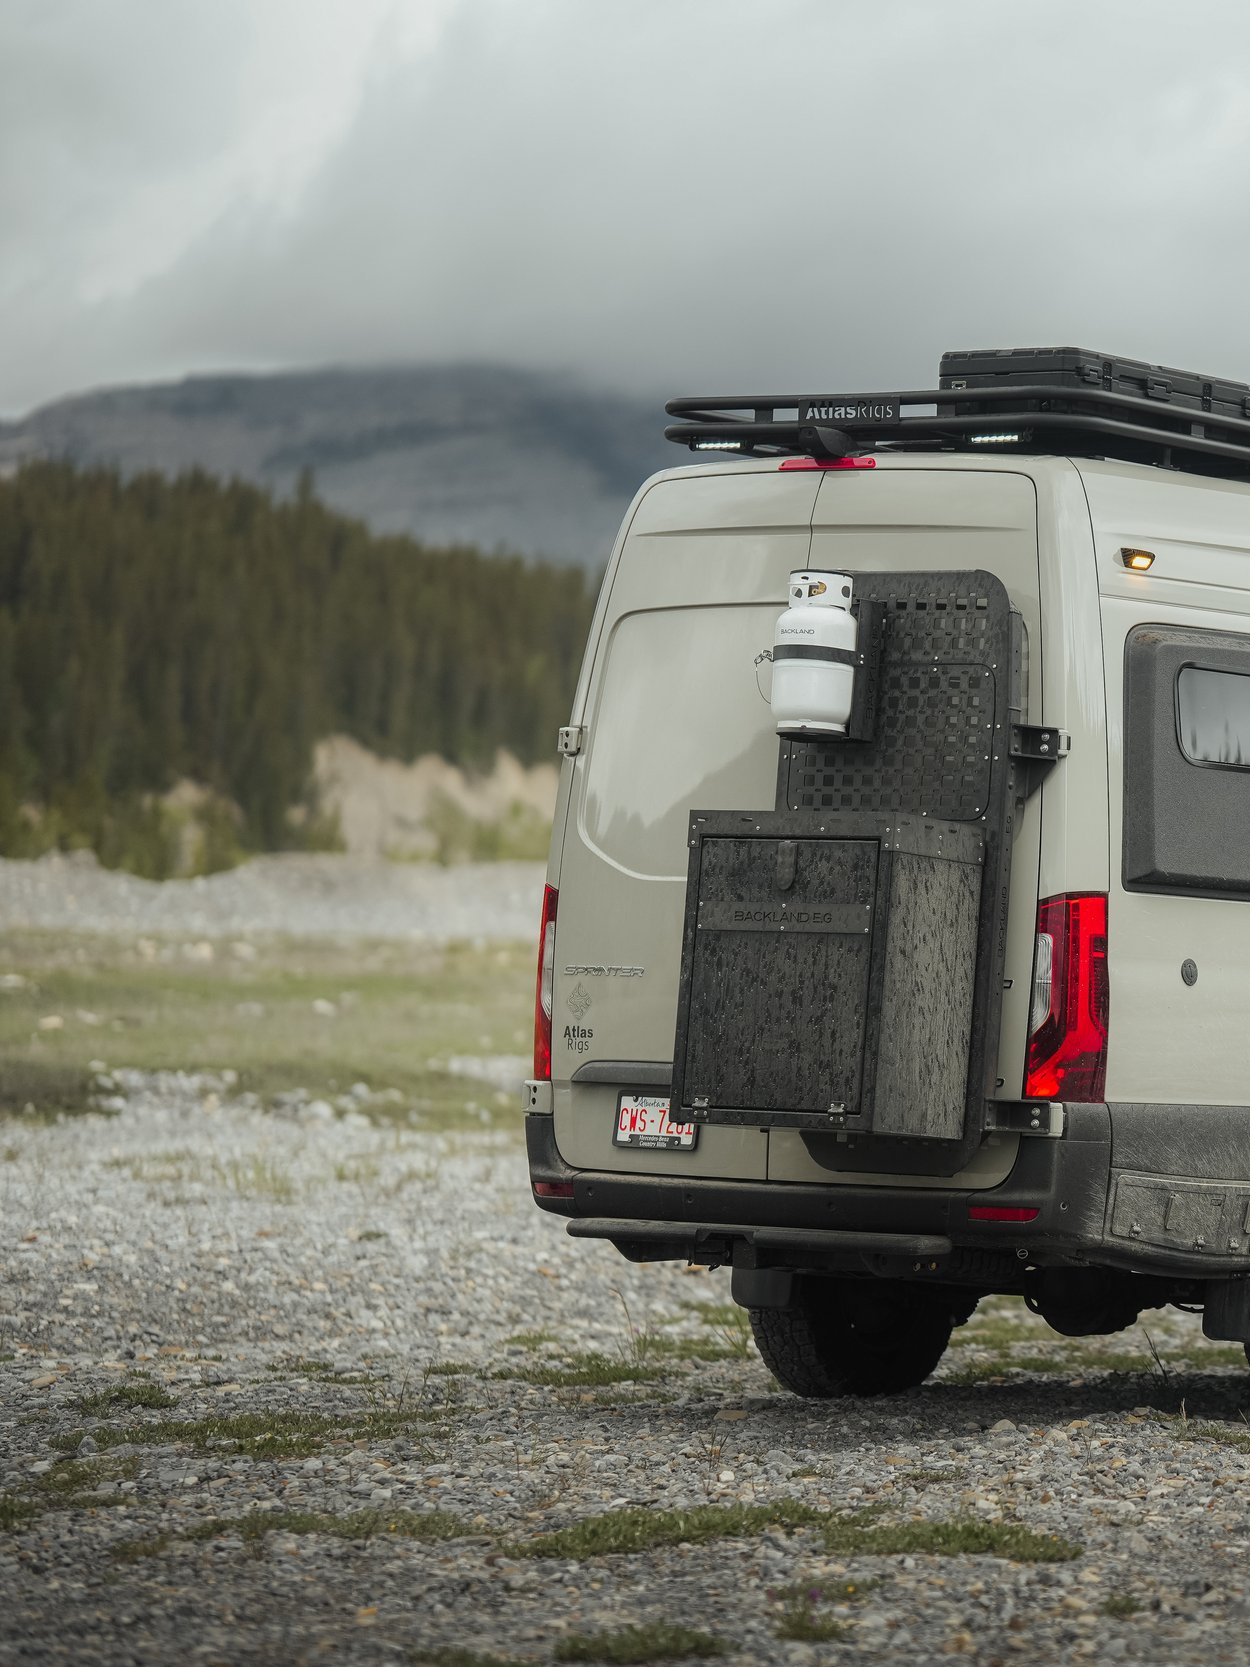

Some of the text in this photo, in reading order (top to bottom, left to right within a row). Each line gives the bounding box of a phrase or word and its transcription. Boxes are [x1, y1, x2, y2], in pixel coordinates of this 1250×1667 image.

[805, 400, 893, 422] AtlasRigs
[734, 910, 810, 923] BACKLAND
[564, 965, 645, 977] SPRINTER
[563, 1026, 594, 1039] Atlas
[567, 1037, 590, 1054] Rigs
